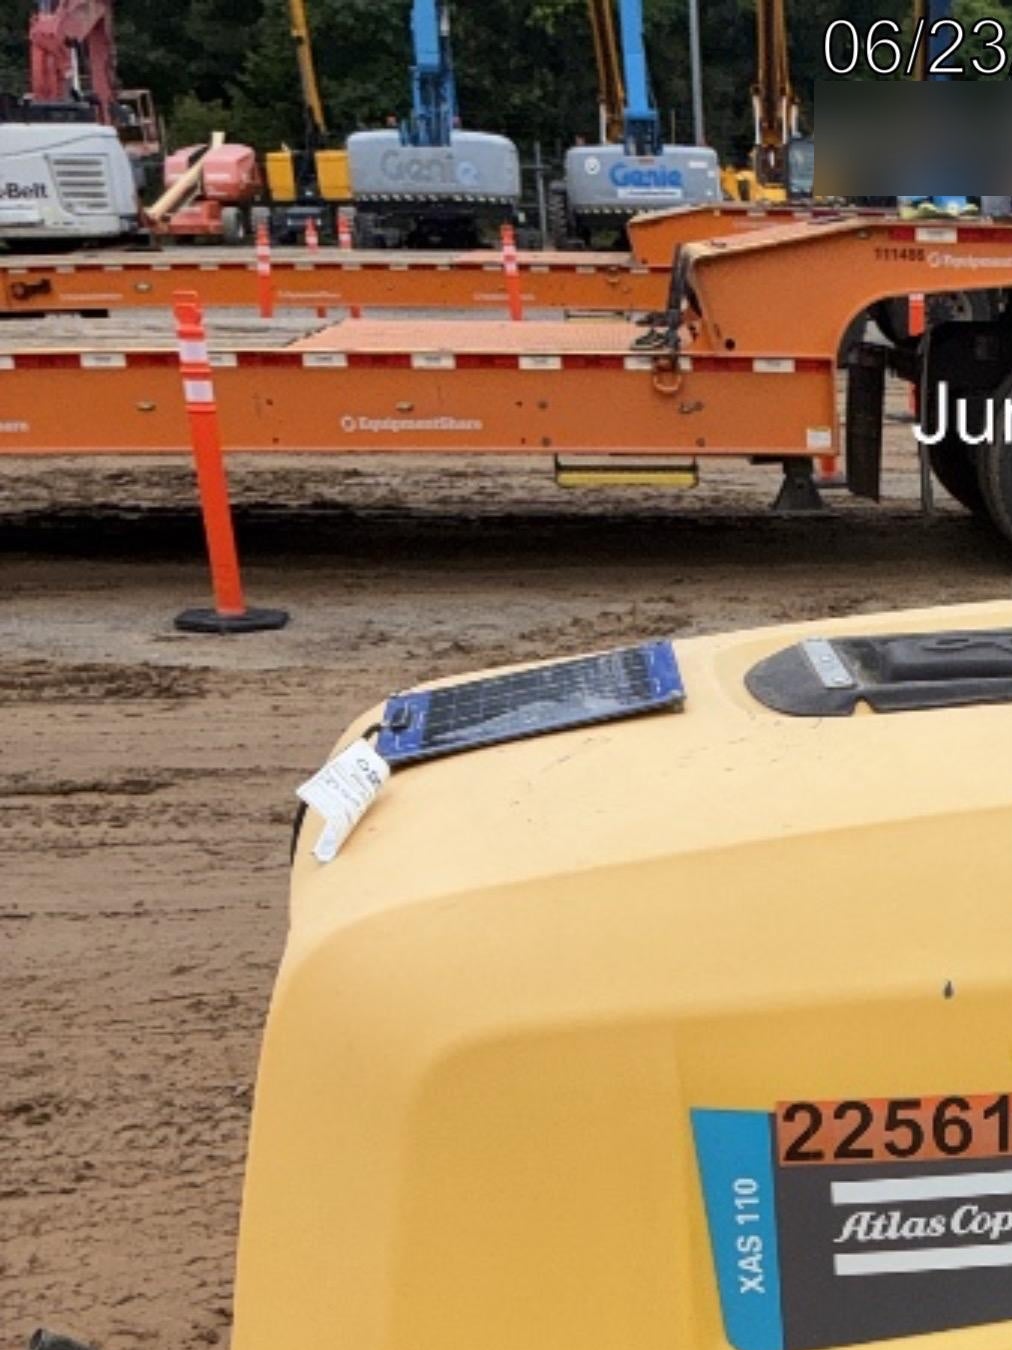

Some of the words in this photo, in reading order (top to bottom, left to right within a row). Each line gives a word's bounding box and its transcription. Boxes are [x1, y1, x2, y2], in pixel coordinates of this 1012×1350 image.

[609, 162, 682, 187] Genie
[732, 1177, 760, 1226] 110
[833, 1211, 946, 1243] Atlas
[737, 1235, 766, 1294] XAS
